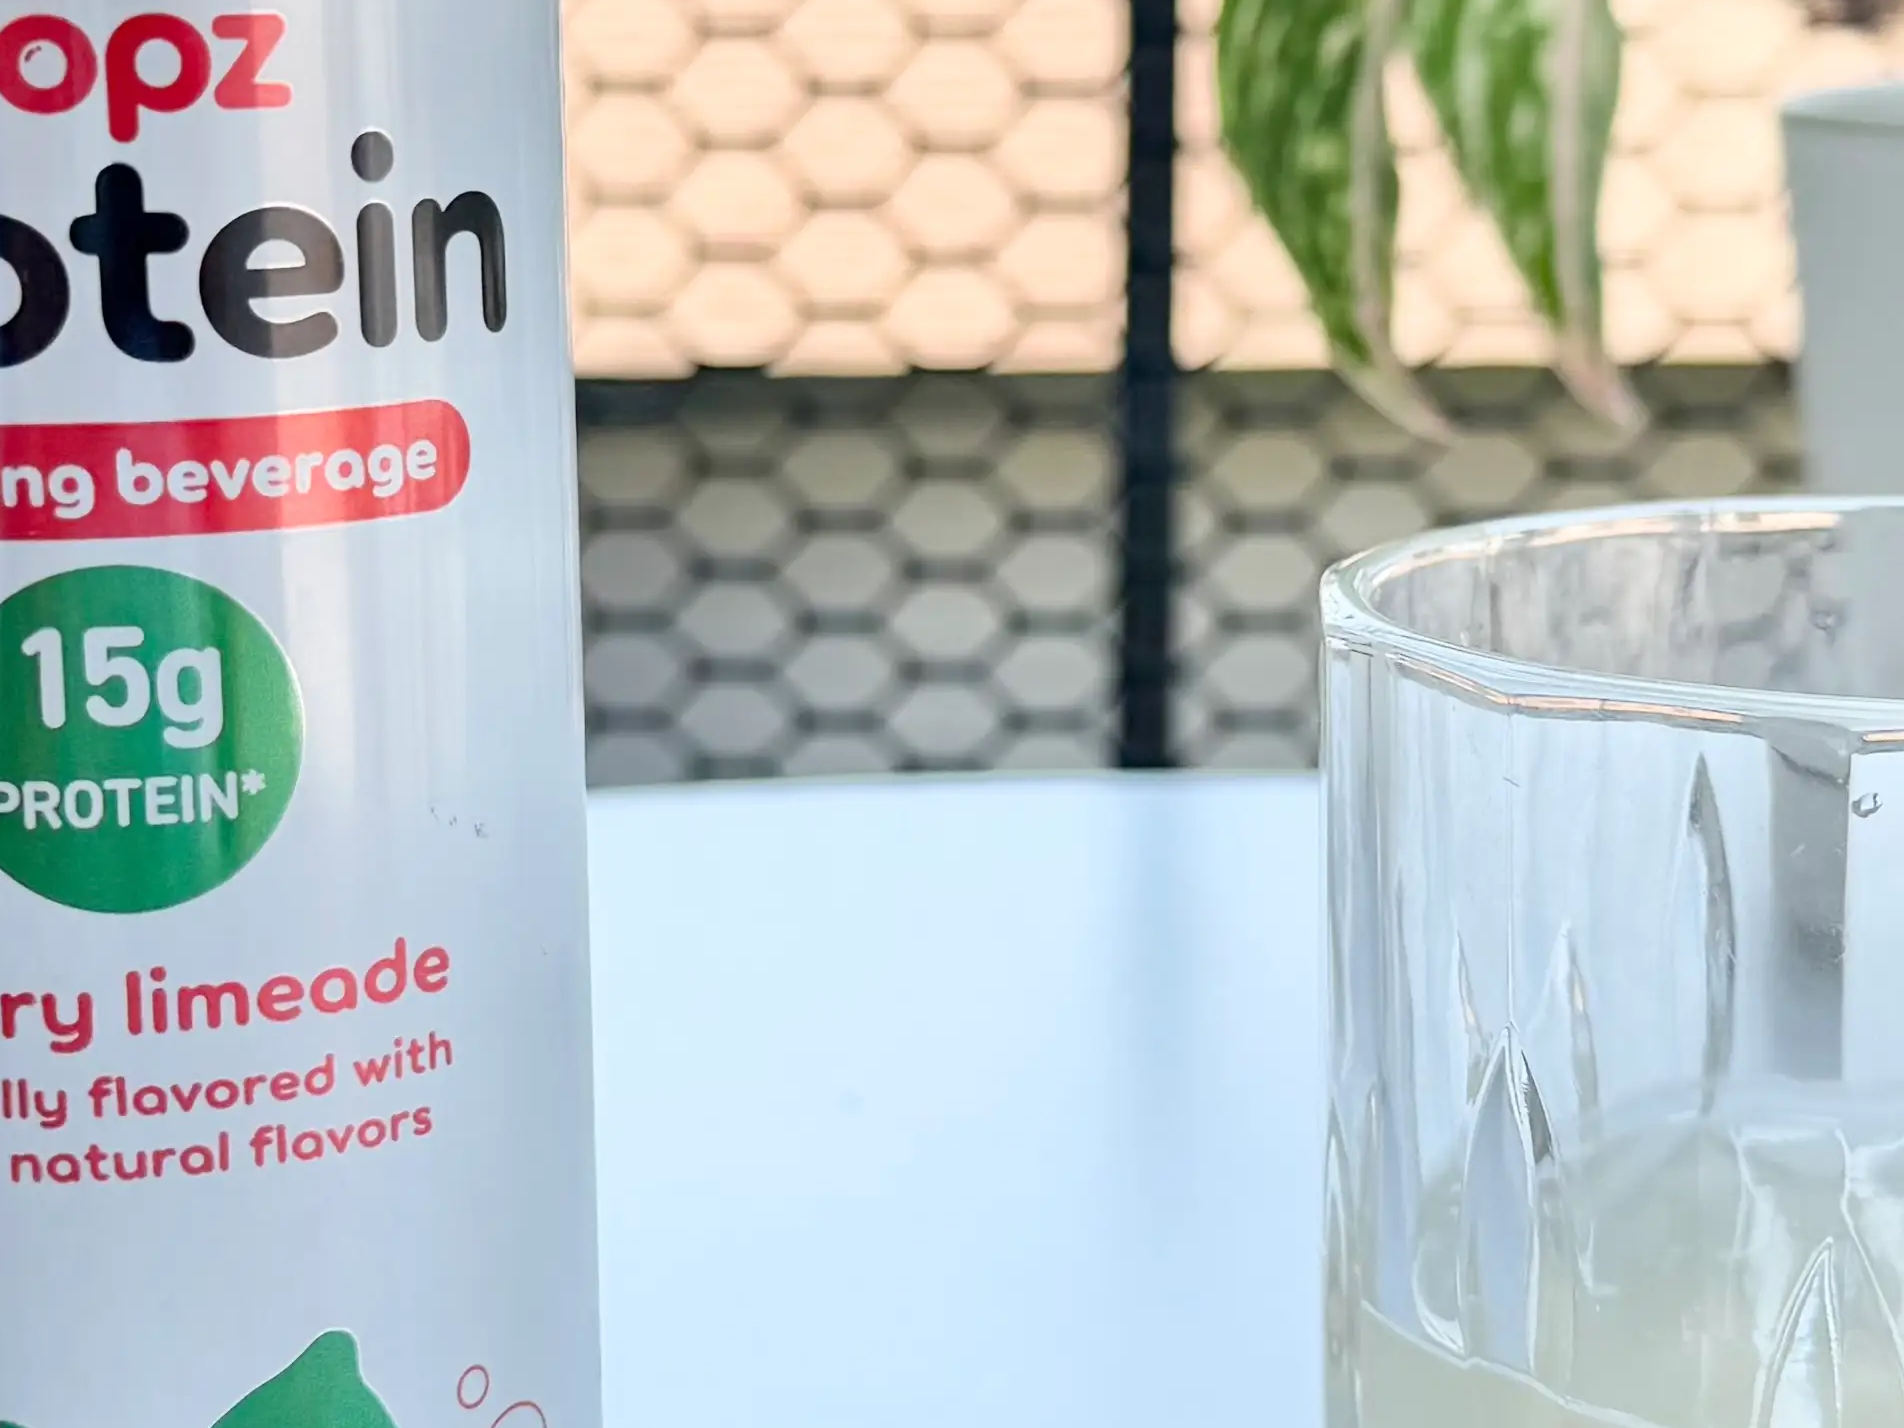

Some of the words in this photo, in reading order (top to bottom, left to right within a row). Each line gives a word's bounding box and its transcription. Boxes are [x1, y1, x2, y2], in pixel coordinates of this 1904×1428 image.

[115, 434, 438, 504] beverage
[20, 625, 223, 750] 15g
[126, 936, 451, 1036] limeade
[88, 1052, 336, 1117] flavored
[352, 1030, 453, 1090] with
[9, 1127, 230, 1184] natural
[249, 1100, 434, 1168] flavors
